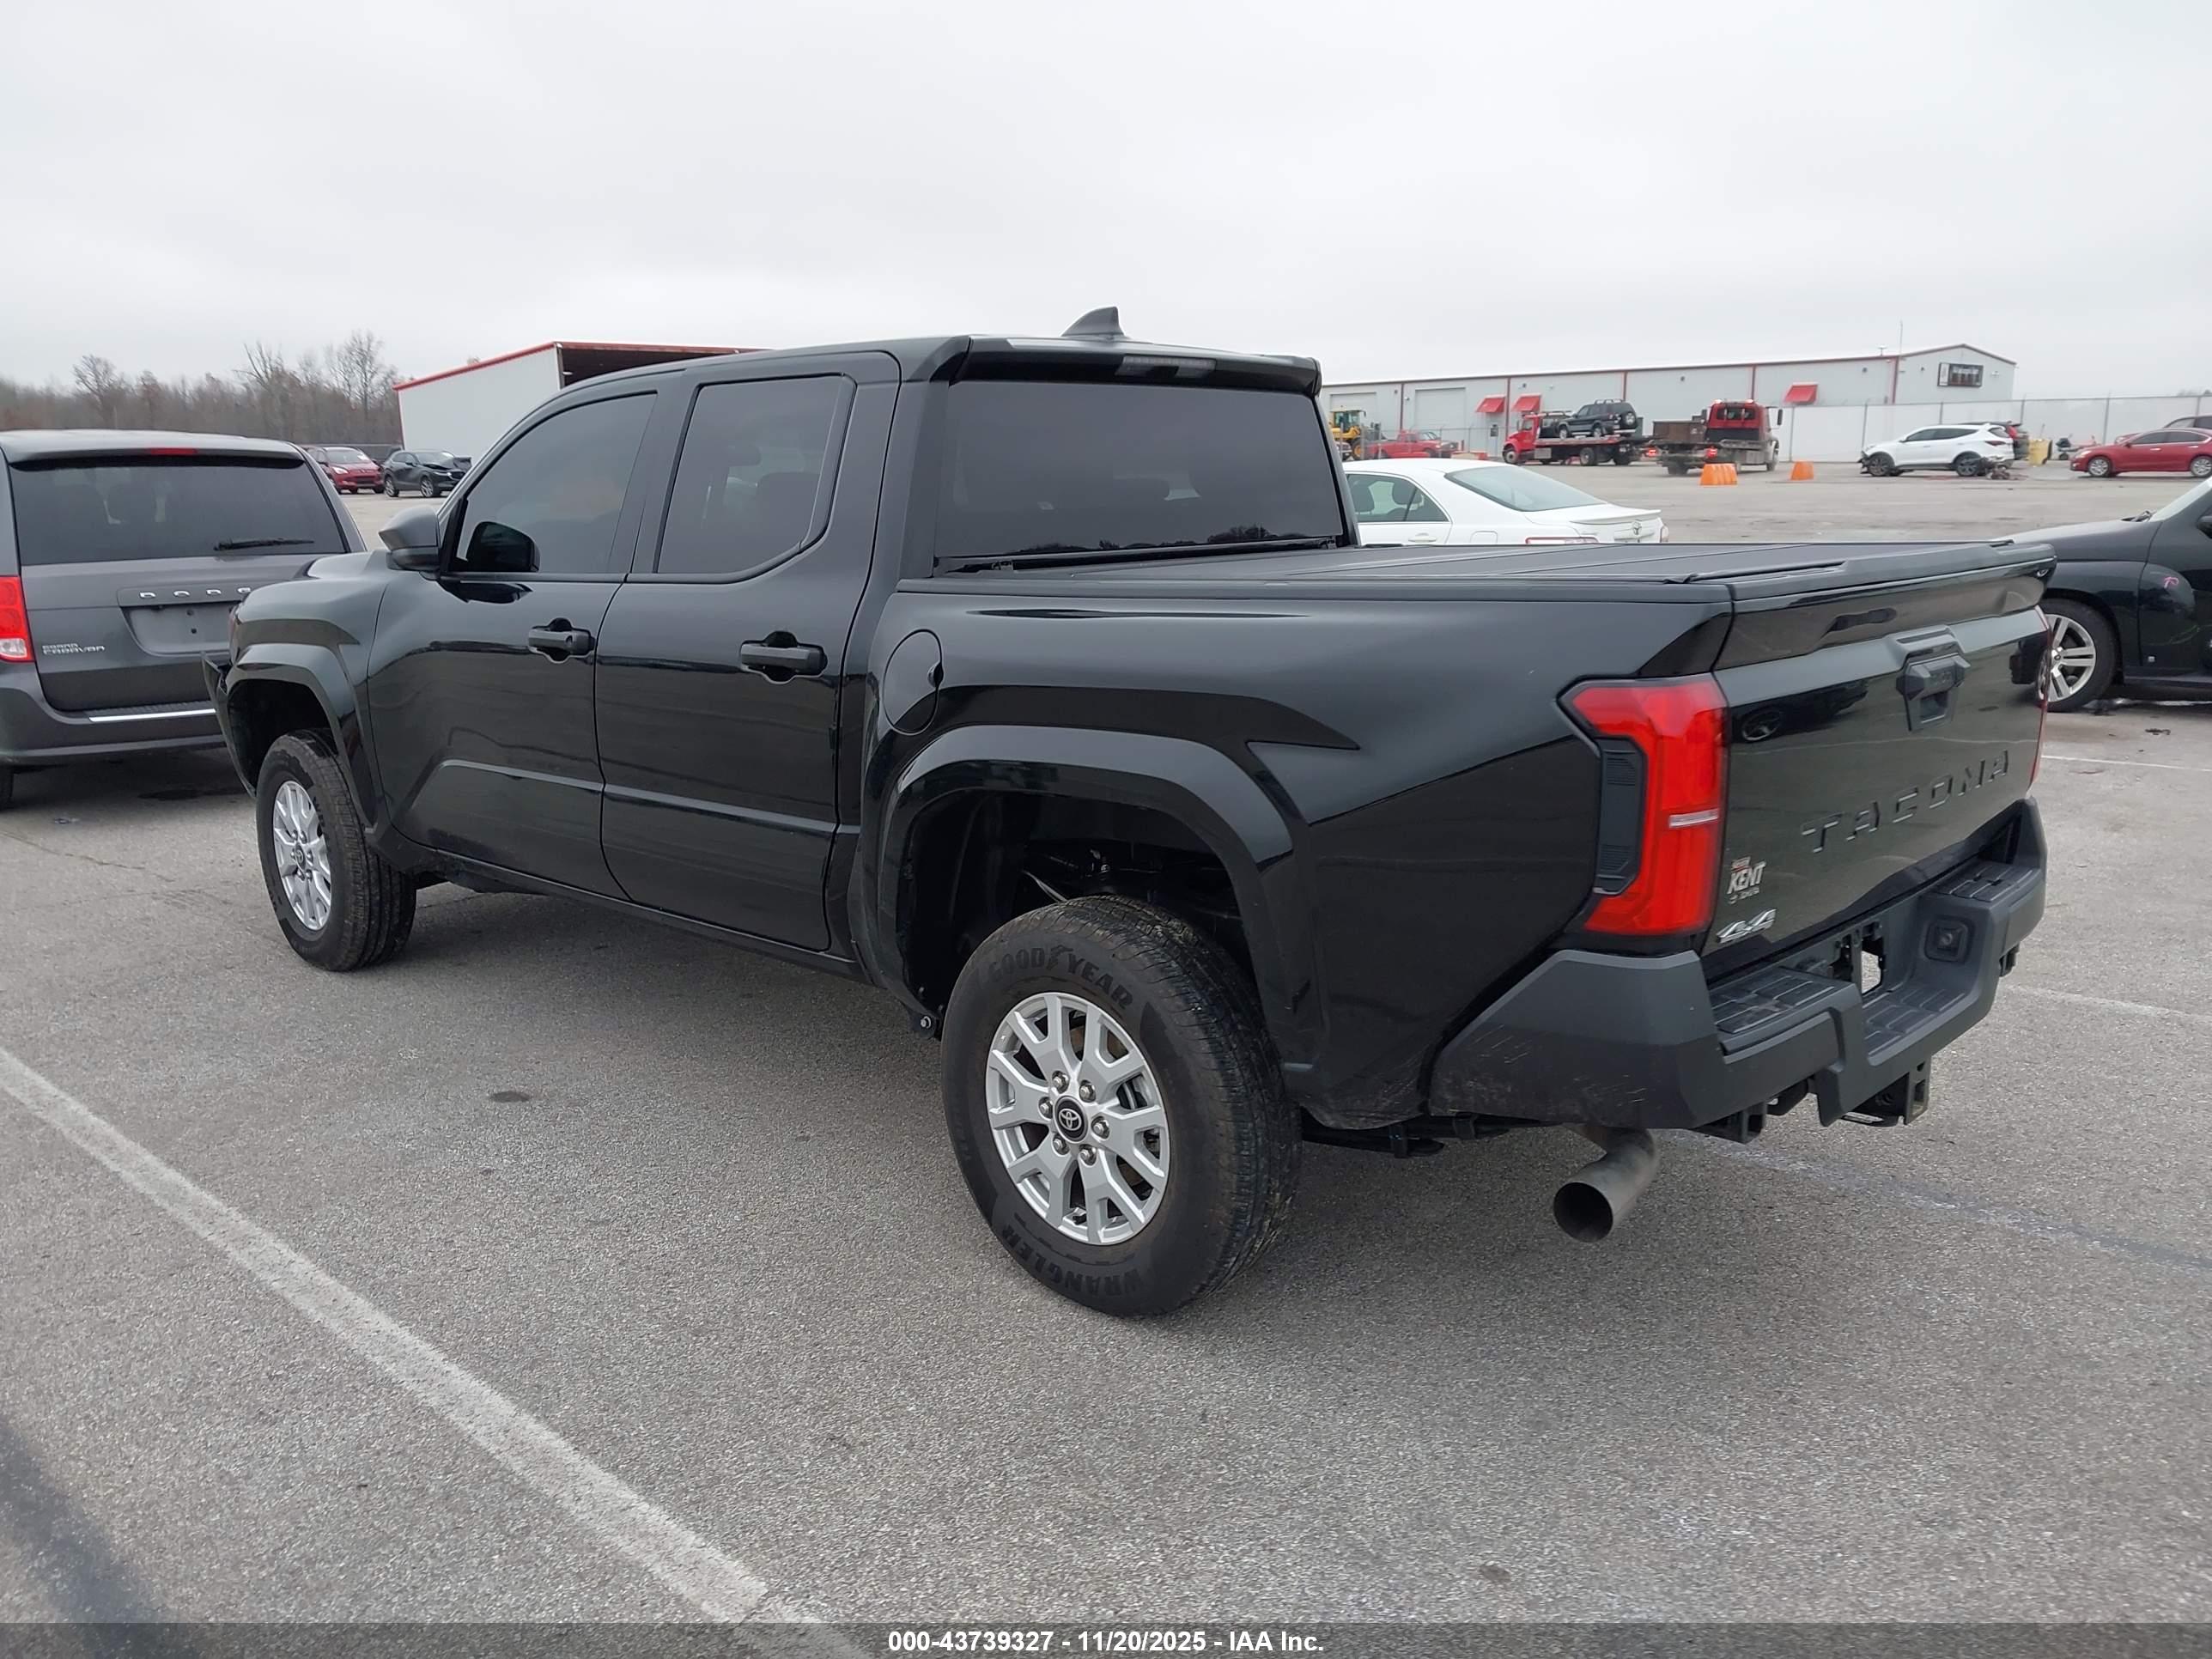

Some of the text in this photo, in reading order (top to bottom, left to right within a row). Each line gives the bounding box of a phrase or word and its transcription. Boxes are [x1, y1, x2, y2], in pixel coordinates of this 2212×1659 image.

[139, 586, 252, 599] DODG
[1800, 750, 2009, 854] TACOMA
[1726, 860, 1766, 895] KENT
[1001, 1224, 1147, 1298] WRANGLER
